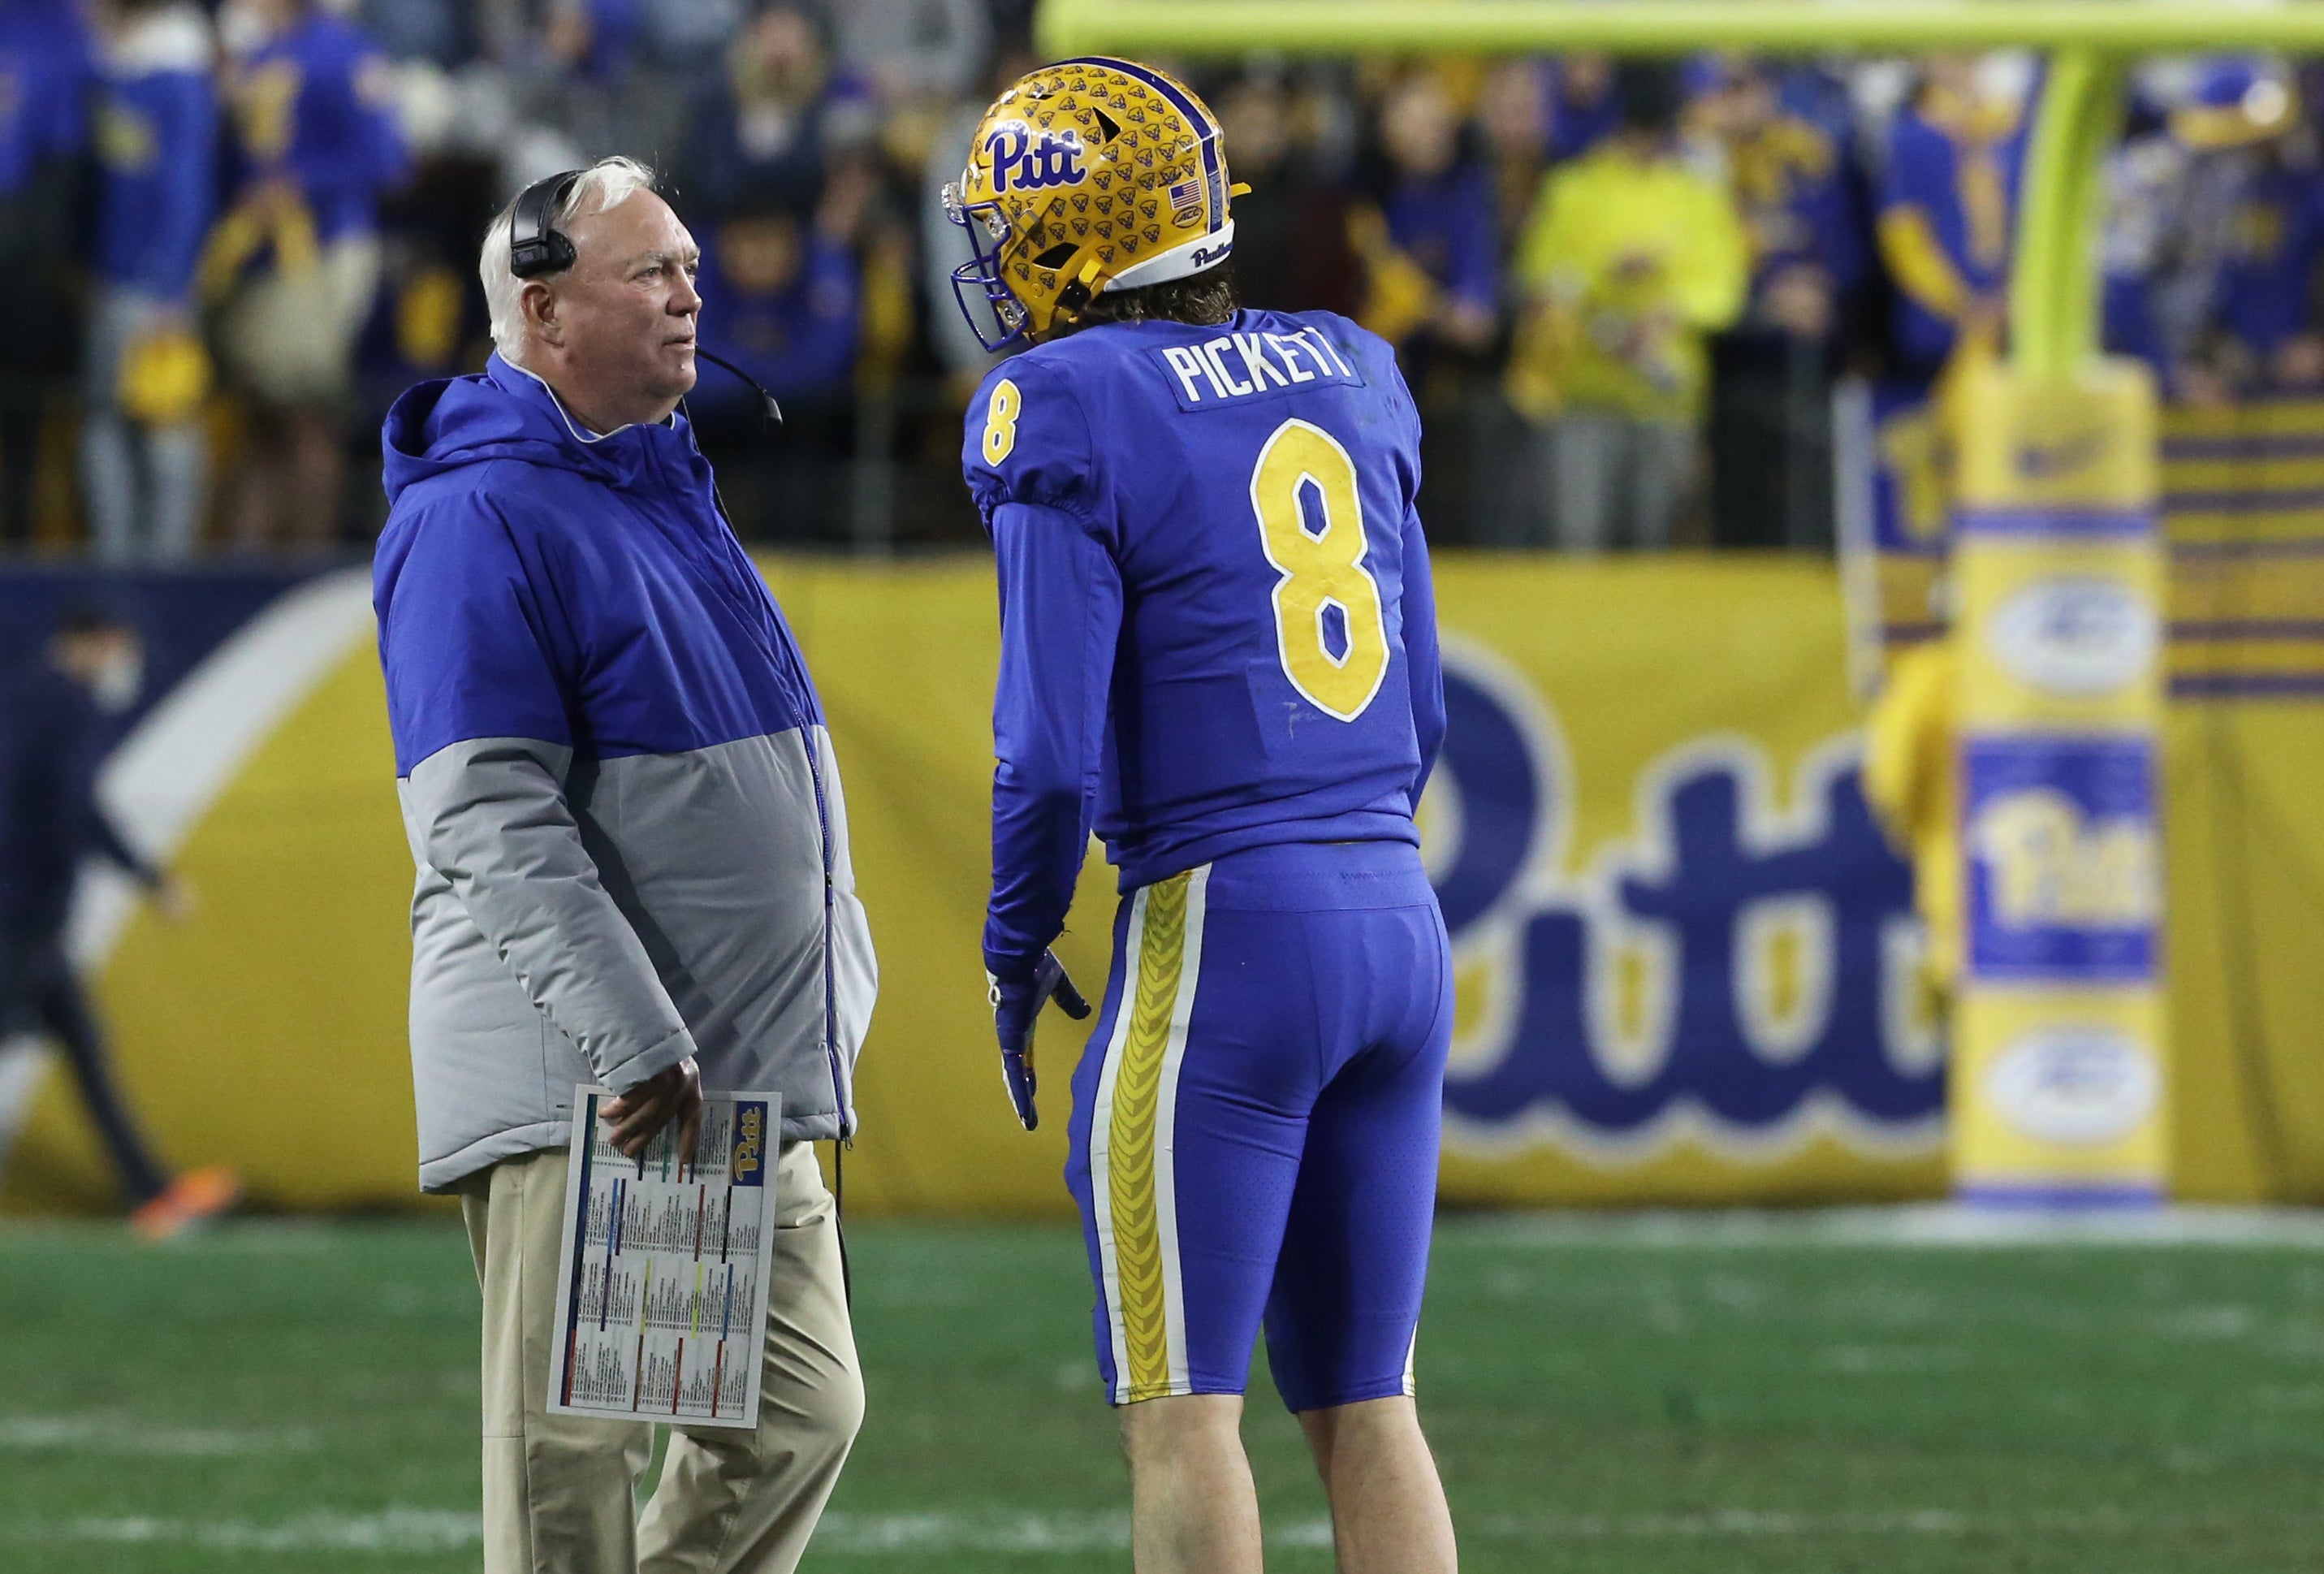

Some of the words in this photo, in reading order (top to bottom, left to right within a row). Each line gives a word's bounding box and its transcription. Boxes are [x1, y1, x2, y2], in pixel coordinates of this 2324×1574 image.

[984, 120, 1086, 194] Pitt
[1177, 208, 1199, 223] ACC
[1162, 326, 1352, 403] PICKETT
[983, 378, 1022, 467] 8
[1250, 417, 1390, 723] 8
[734, 1105, 761, 1182] Pitt
